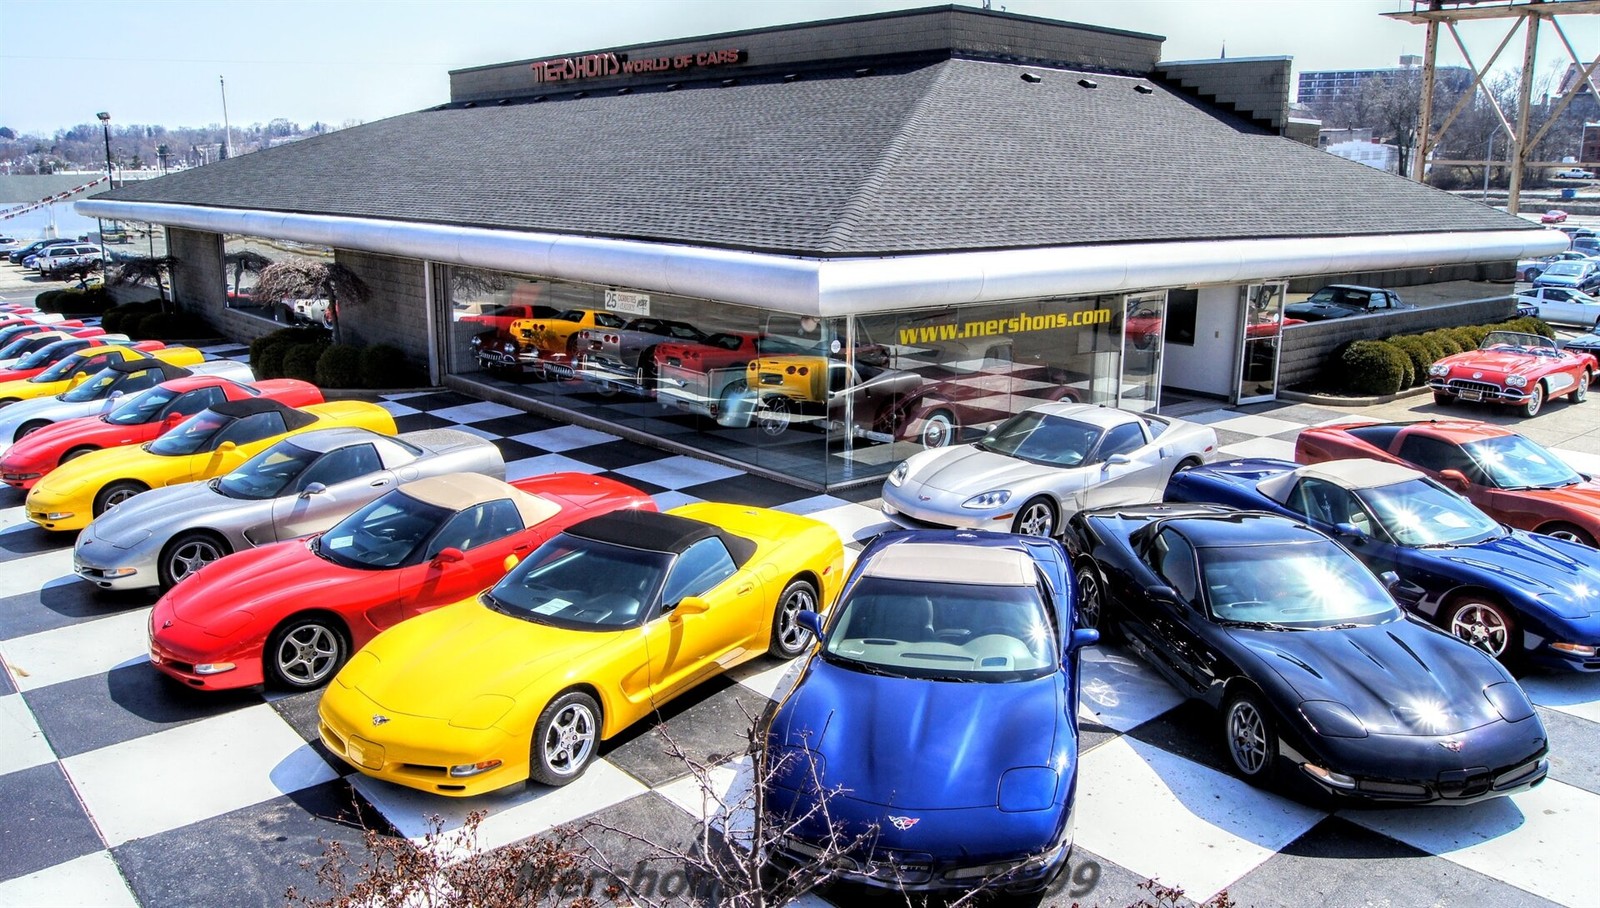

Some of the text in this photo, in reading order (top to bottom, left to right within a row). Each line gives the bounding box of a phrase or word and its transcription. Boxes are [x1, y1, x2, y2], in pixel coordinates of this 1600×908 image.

[622, 57, 670, 73] WORLD
[673, 54, 693, 69] OF
[697, 48, 739, 66] CARS
[606, 292, 616, 308] 25
[900, 308, 1111, 345] www.mershons.com
